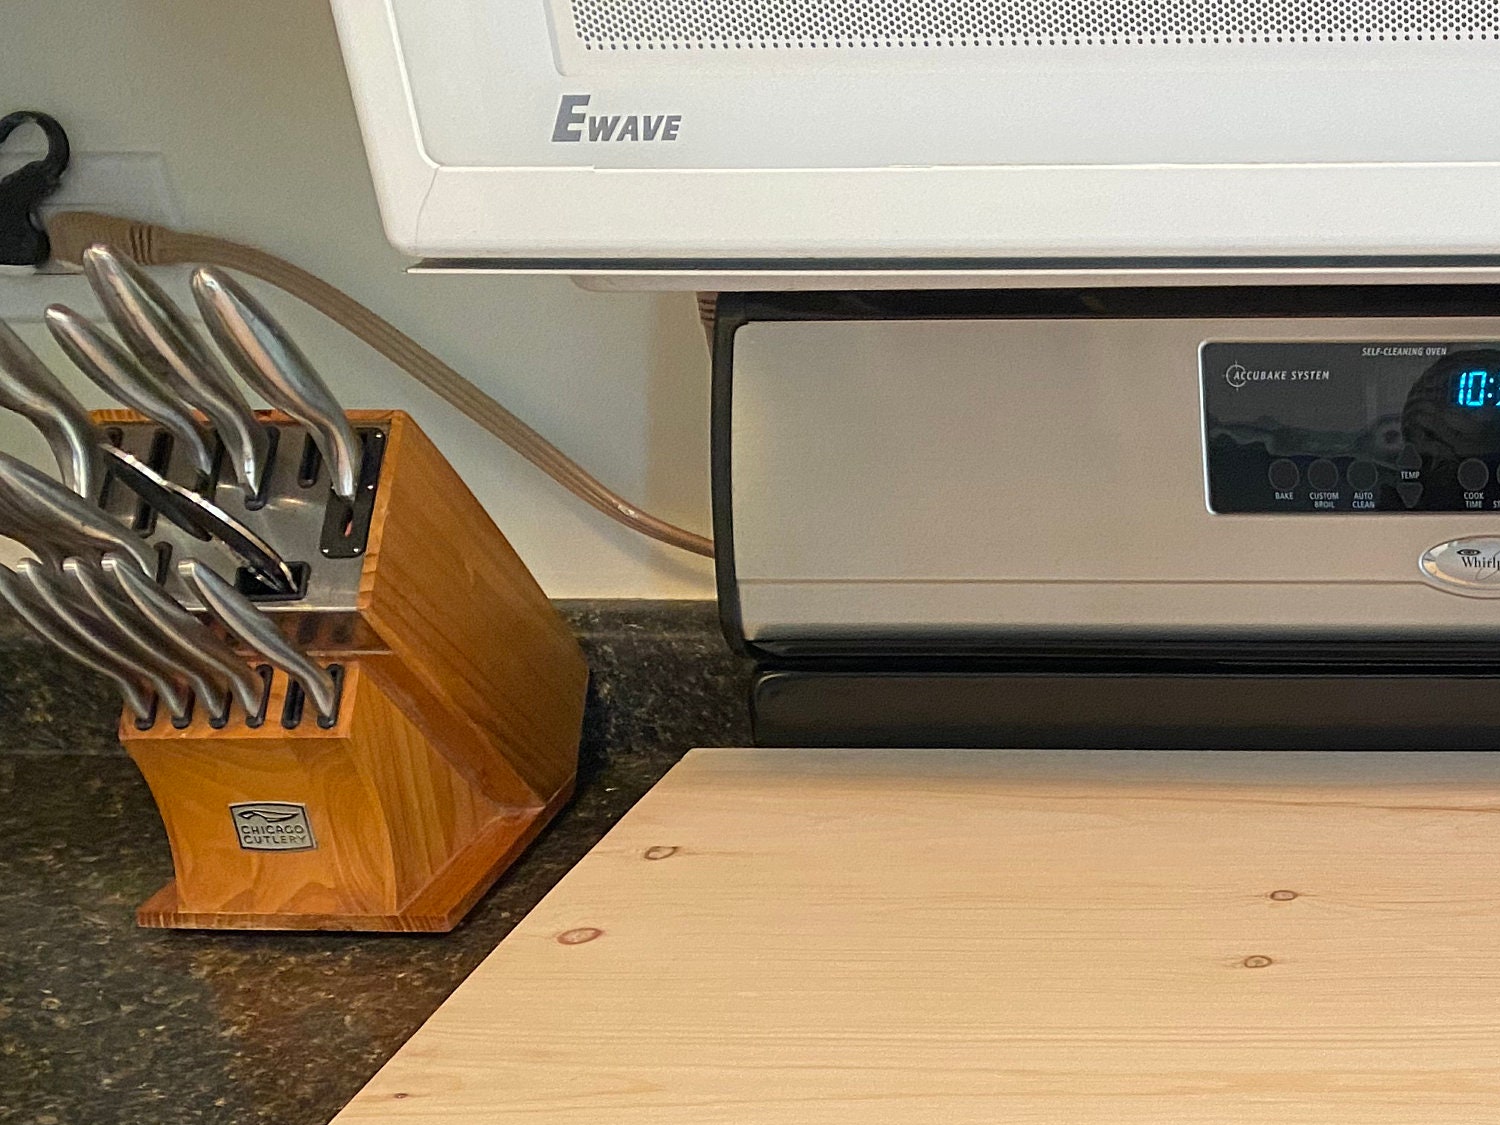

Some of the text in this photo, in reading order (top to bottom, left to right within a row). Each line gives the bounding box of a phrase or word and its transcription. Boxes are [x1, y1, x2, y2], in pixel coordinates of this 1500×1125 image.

[1362, 347, 1447, 357] SELF-CLEANING OVEN
[1291, 371, 1330, 380] SYSTEM
[1401, 471, 1420, 479] TEMP
[1275, 492, 1294, 500] BAKE
[1309, 492, 1339, 500] CUSTOM
[1354, 492, 1373, 500] AUTO
[1463, 491, 1485, 499] COOK
[1314, 500, 1335, 508] BROIL
[1352, 500, 1375, 508] CLEAN
[1465, 500, 1483, 508] TIME
[241, 825, 304, 834] CHICAGO
[243, 835, 306, 844] CUTLERY
